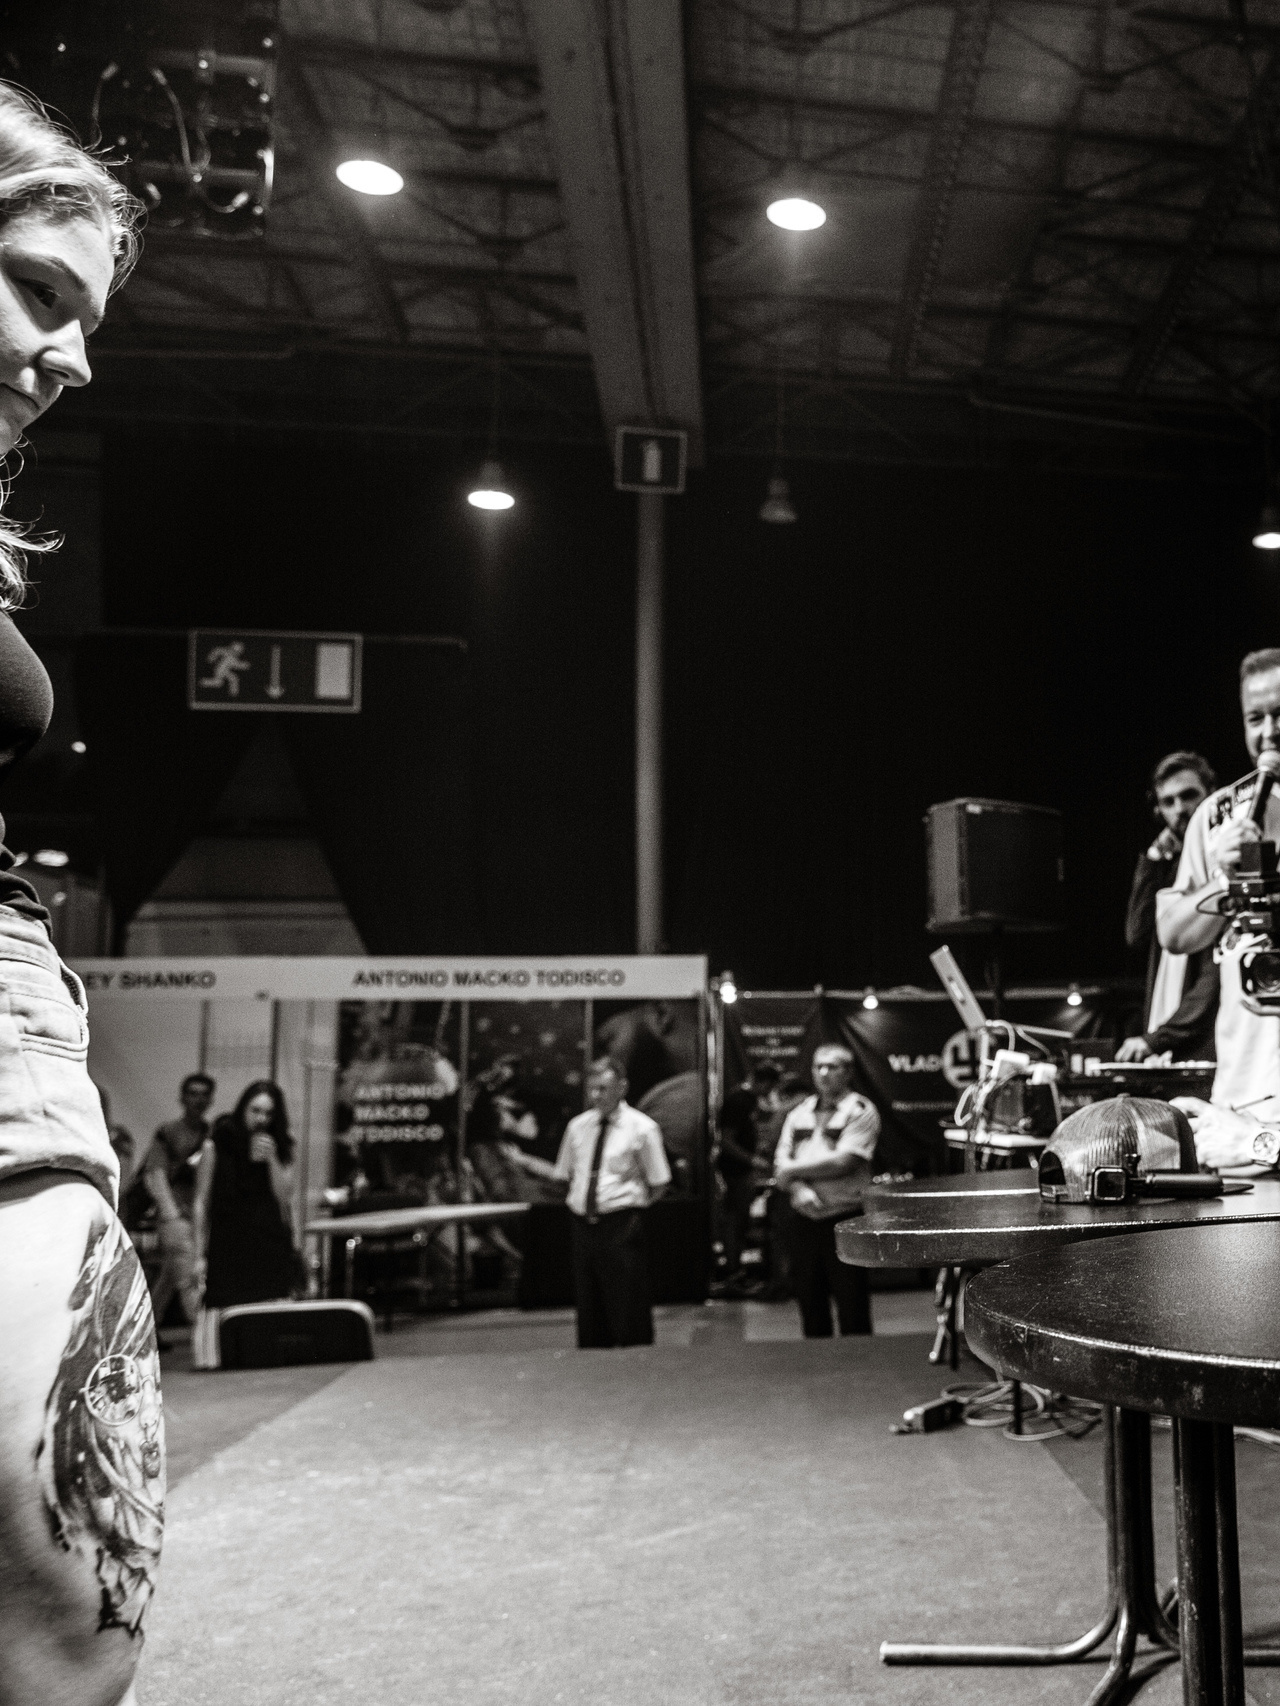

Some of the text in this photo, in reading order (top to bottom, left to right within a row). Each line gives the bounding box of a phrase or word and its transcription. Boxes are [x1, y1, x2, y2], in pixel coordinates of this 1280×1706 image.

[80, 970, 217, 990] EY SHANKO
[353, 968, 626, 988] ANTONIO MACKO TODISCO
[355, 1082, 446, 1101] ANTONIO
[354, 1103, 430, 1121] MACKO
[351, 1124, 445, 1143] TODISCO
